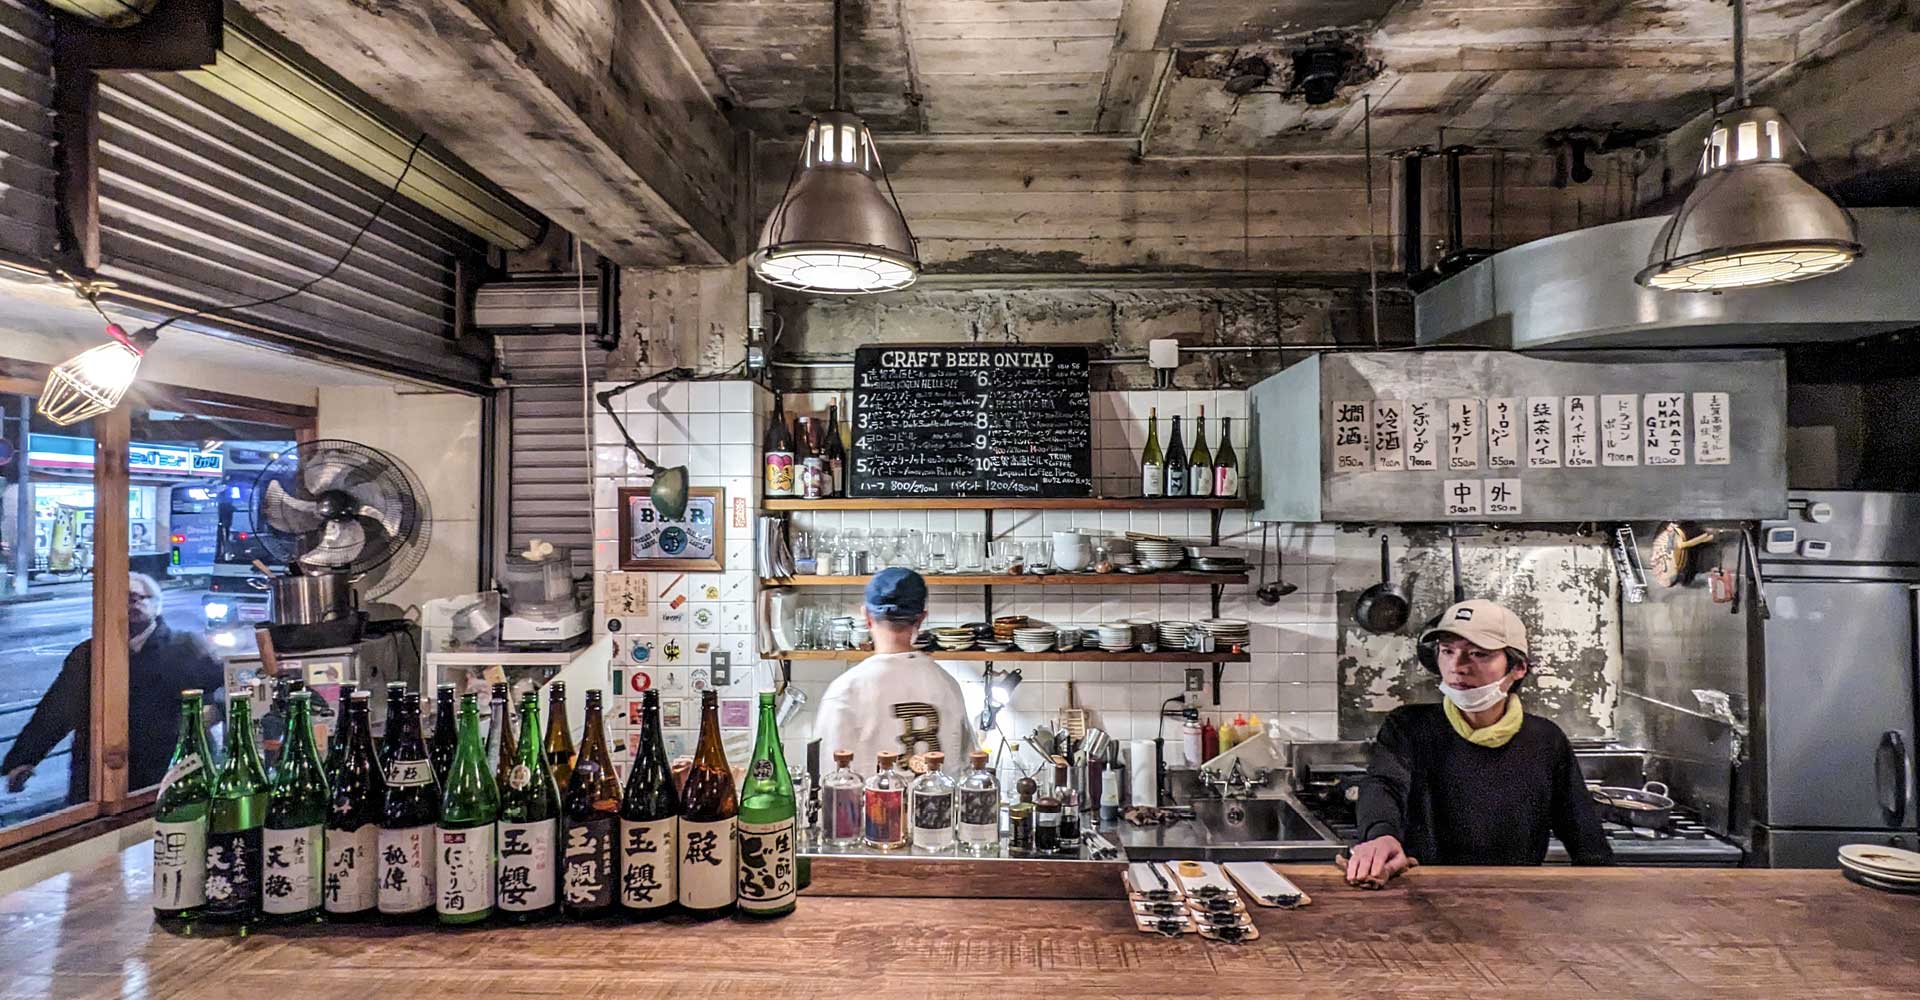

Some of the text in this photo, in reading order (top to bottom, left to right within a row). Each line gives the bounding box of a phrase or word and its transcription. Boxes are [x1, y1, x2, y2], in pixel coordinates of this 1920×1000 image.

[881, 351, 941, 368] CRAFT
[946, 352, 990, 368] BEER
[1375, 408, 1400, 451] 冷酒
[1463, 404, 1473, 437] レモン
[1497, 402, 1510, 438] ウーロン
[1618, 400, 1633, 441] ドラゴン
[1658, 400, 1668, 429] UMI
[1669, 396, 1682, 456] YAMATO
[1450, 422, 1463, 455] サワー
[1646, 416, 1659, 448] GIN
[1454, 482, 1471, 505] 中
[1491, 482, 1512, 503] 外
[443, 846, 465, 911] にごり酒
